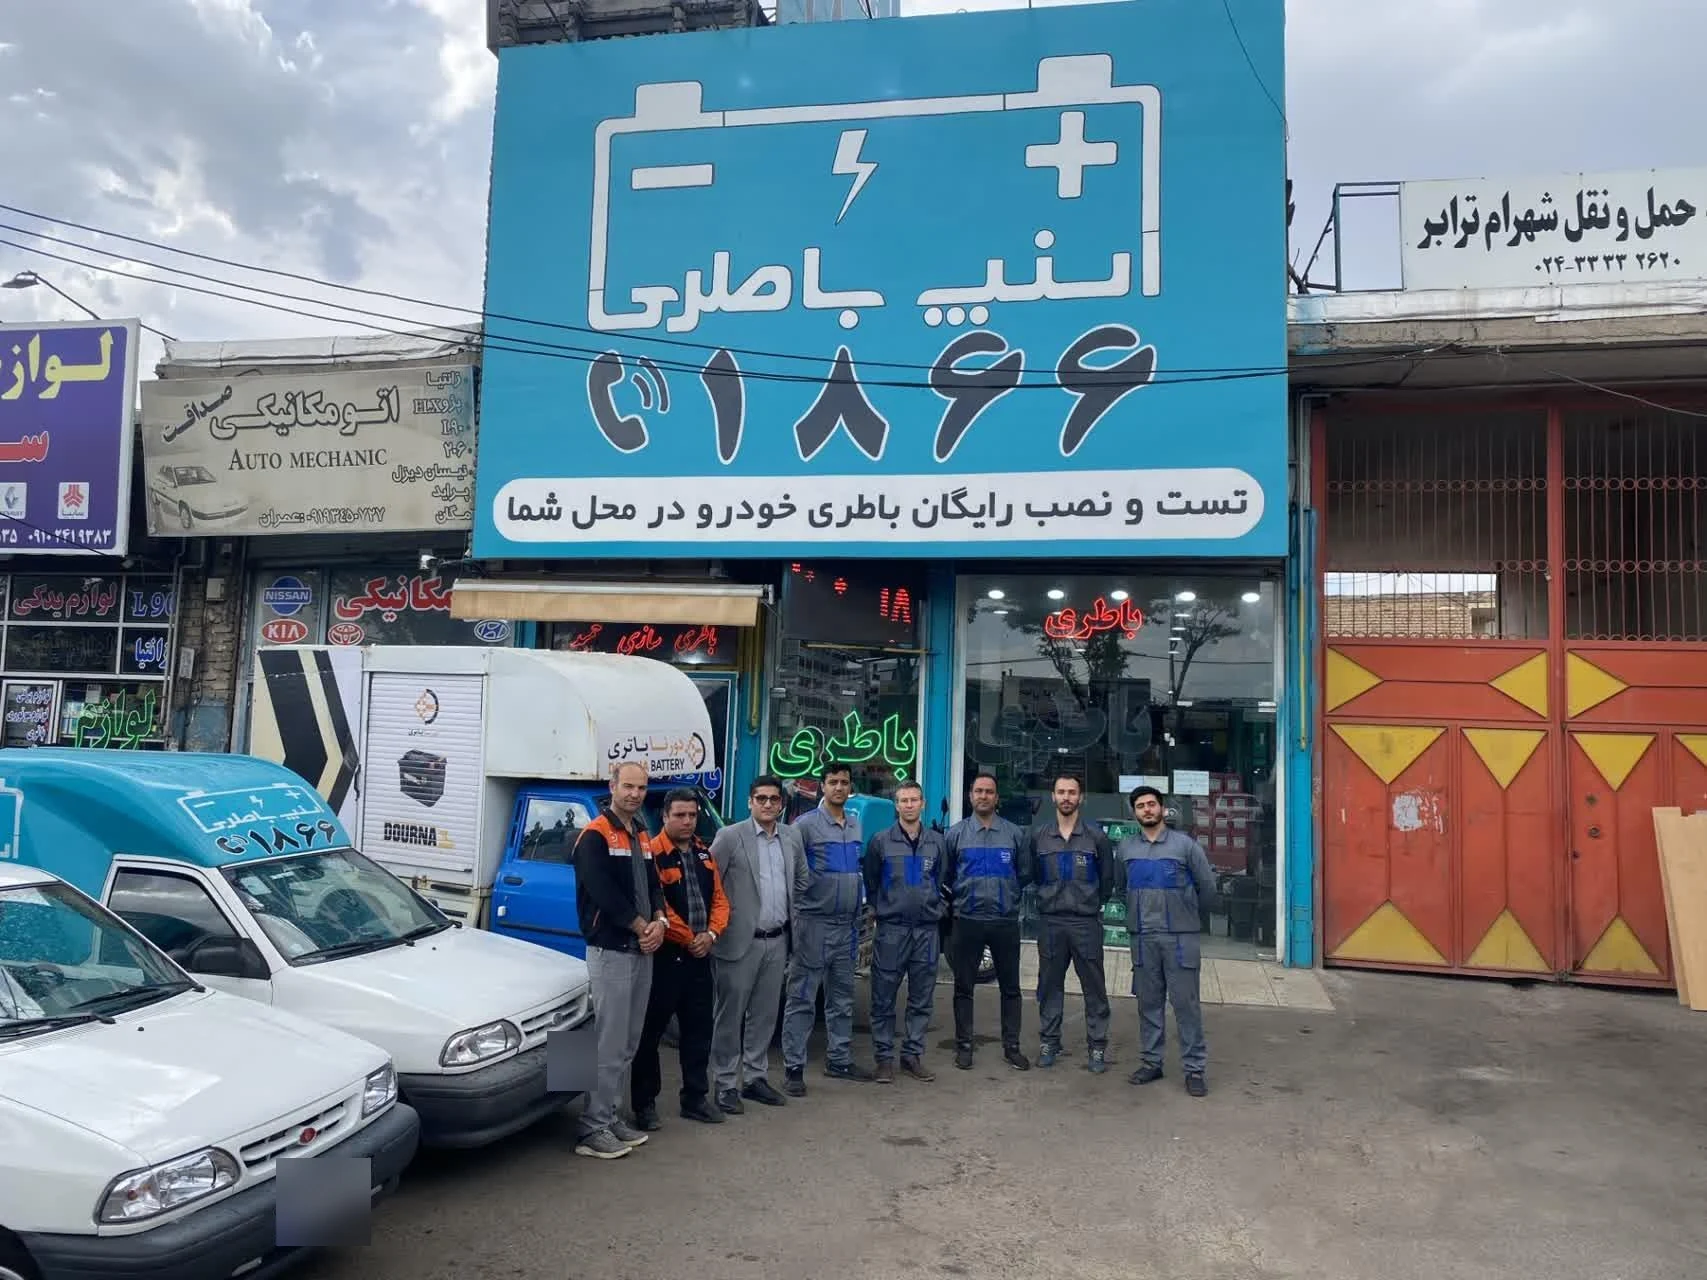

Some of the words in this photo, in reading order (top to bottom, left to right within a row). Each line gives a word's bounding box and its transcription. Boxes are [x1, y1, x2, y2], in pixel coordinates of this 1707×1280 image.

[1416, 195, 1480, 249] ترابر
[1484, 190, 1558, 251] شهرام
[1564, 188, 1610, 242] نقل
[1615, 206, 1629, 241] و
[1635, 186, 1696, 240] حمل
[0, 329, 114, 399] لواز
[699, 323, 1157, 465] ۱۸۶۶
[162, 384, 233, 443] صداقت
[228, 448, 282, 471] AUTO
[290, 448, 388, 469] MECHANIC
[507, 491, 562, 522] شما
[571, 494, 637, 530] محل
[647, 499, 686, 529] در
[807, 493, 901, 530] باطری
[912, 486, 1013, 529] رایگان
[1024, 490, 1113, 528] نصب
[1124, 497, 1144, 525] و
[1156, 489, 1248, 516] تست
[264, 590, 309, 601] NISSAN
[267, 624, 299, 639] KIA
[1045, 598, 1143, 640] باطری
[607, 736, 649, 760] باتری
[770, 710, 916, 781] باطری
[650, 758, 685, 772] BATTERY
[249, 819, 336, 854] ۱۸۶۶
[383, 822, 438, 848] DOURNA
